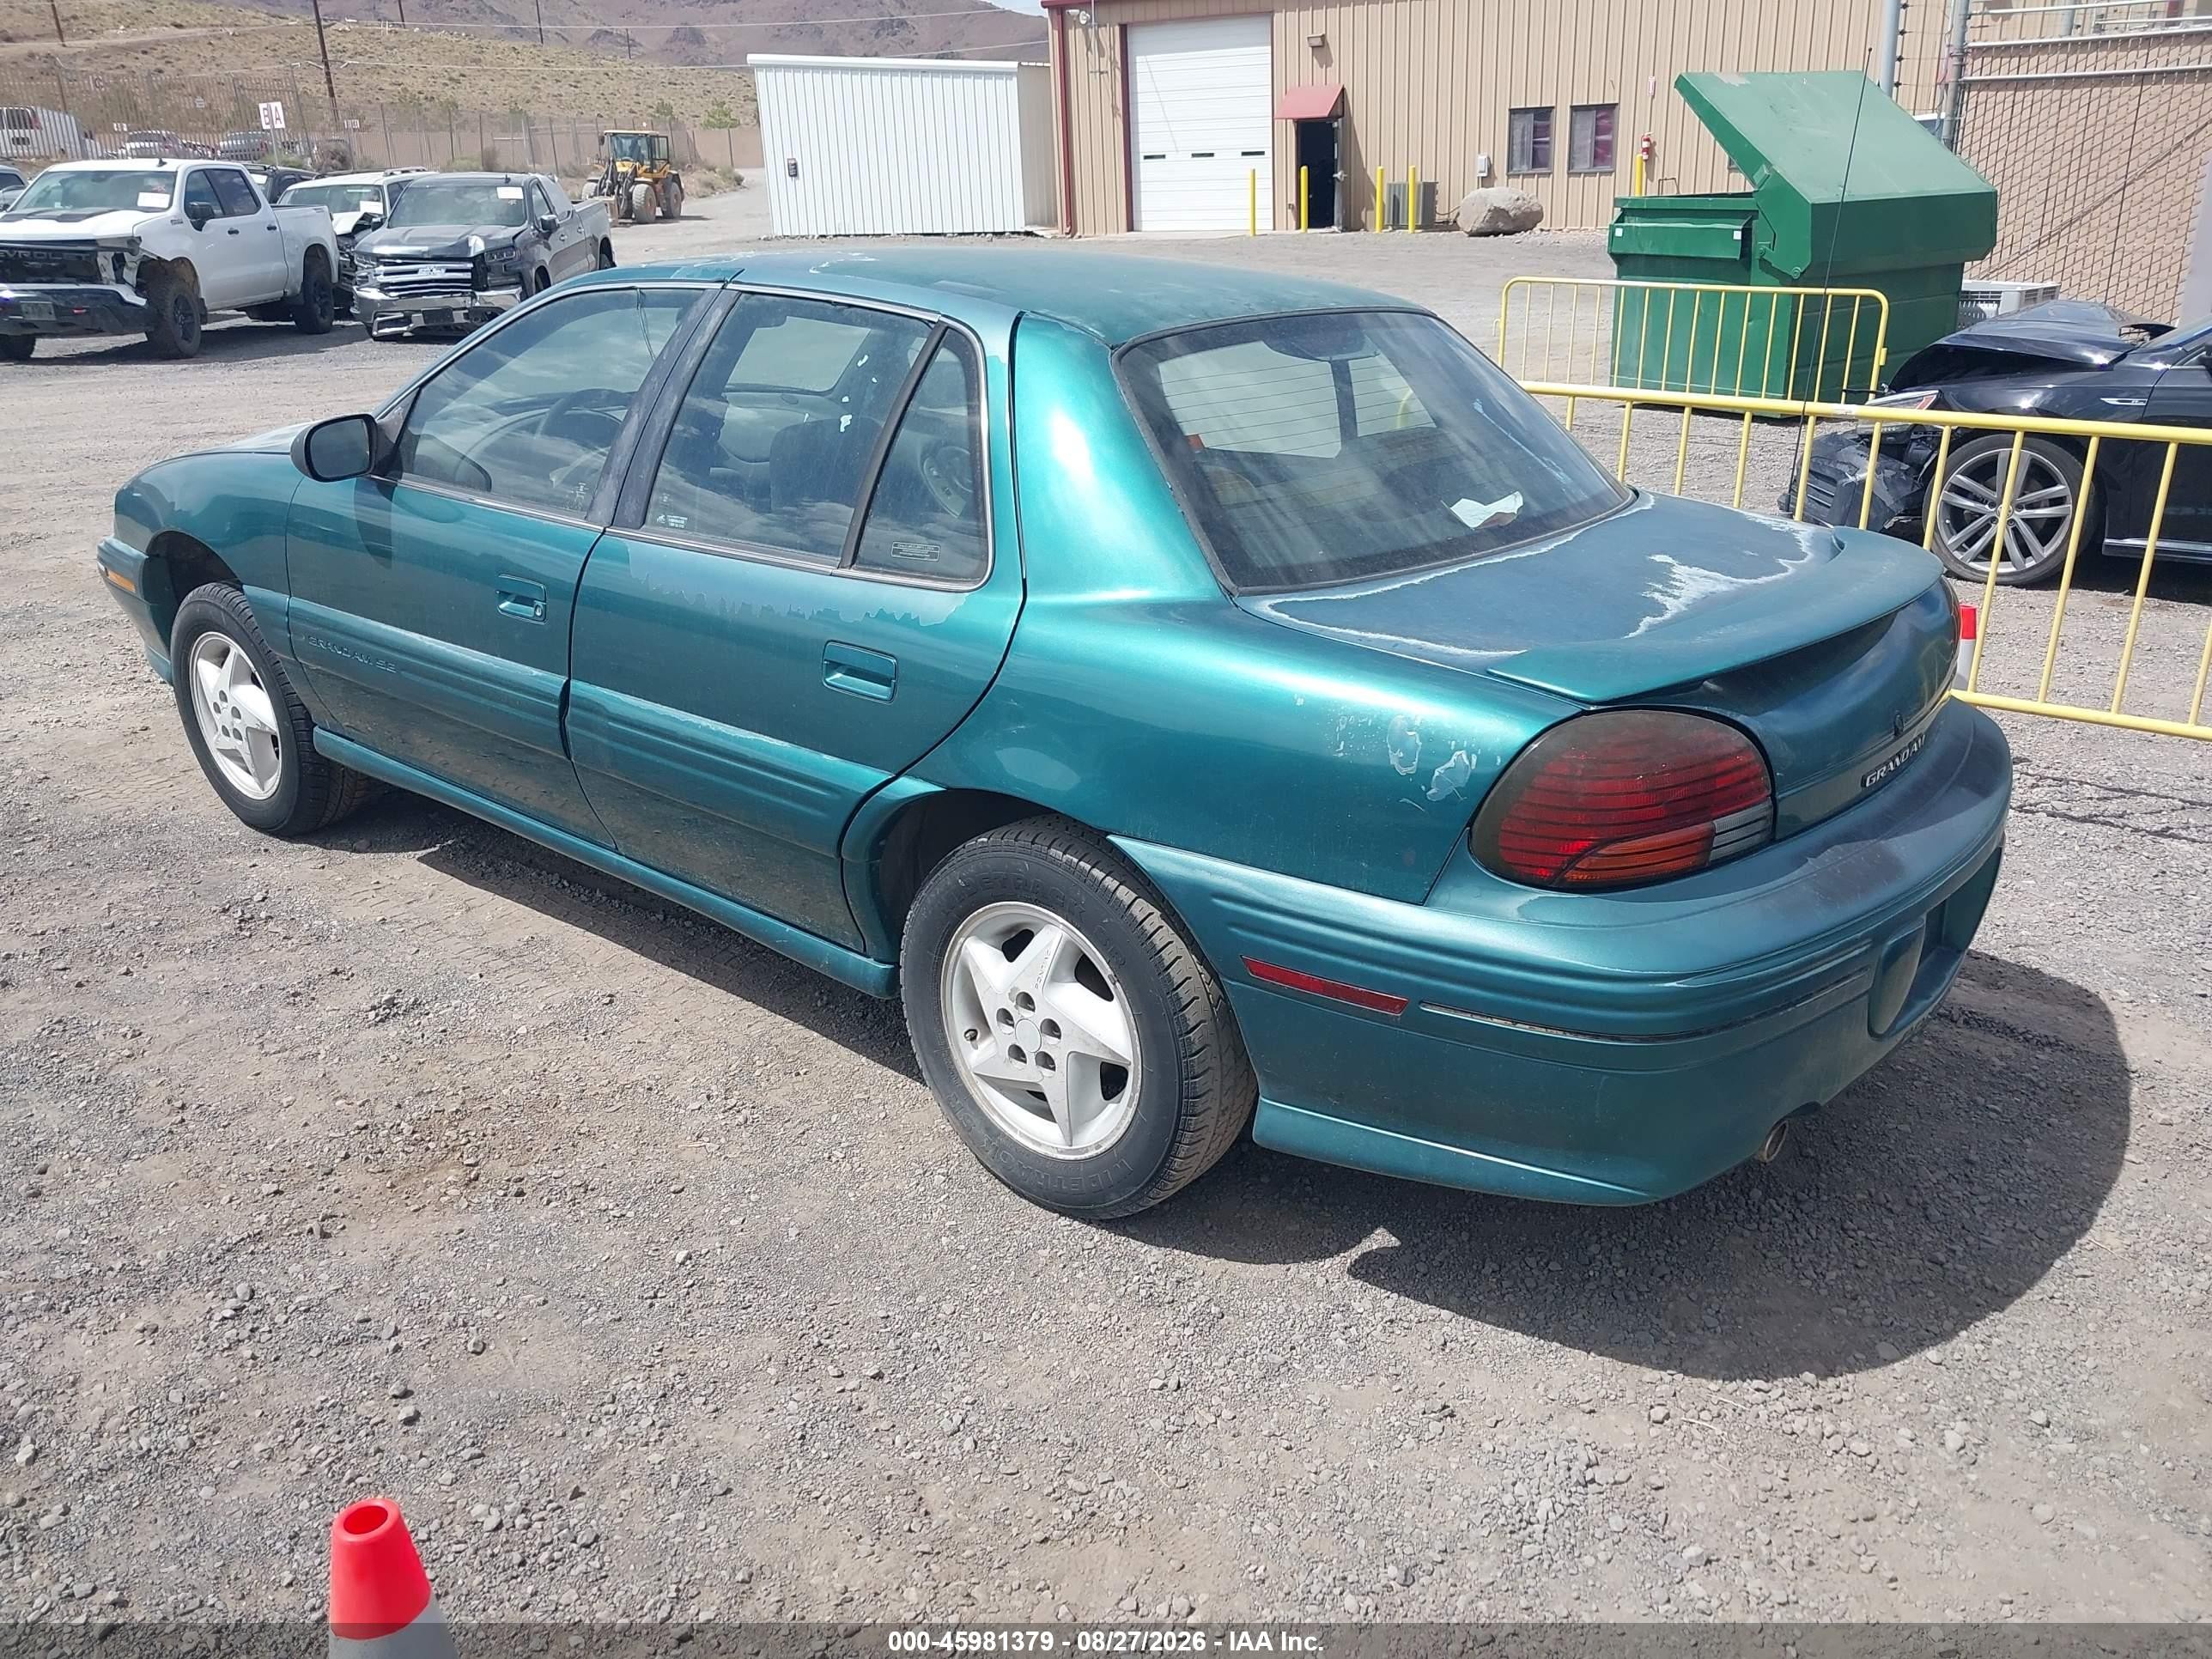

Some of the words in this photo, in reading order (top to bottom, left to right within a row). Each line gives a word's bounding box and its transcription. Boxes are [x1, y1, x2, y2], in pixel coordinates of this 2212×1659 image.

[262, 107, 271, 125] B
[274, 106, 283, 125] A
[1865, 748, 1911, 787] GRAND
[1034, 948, 1051, 990] PONTIAC
